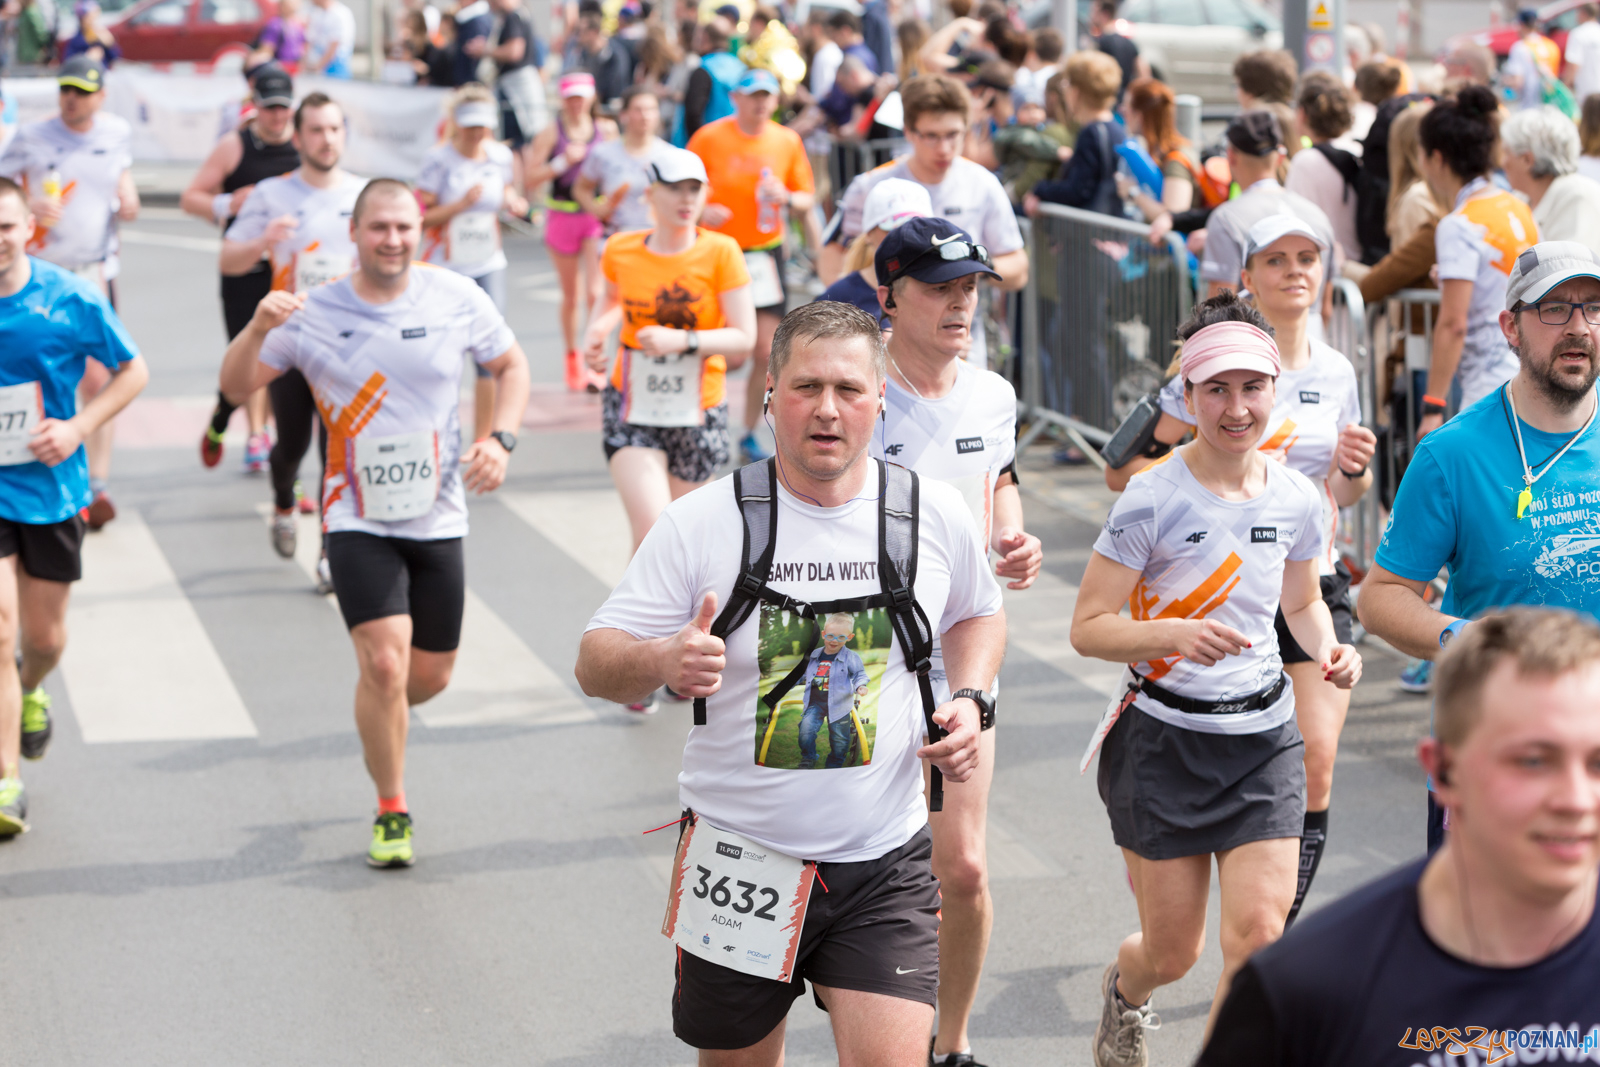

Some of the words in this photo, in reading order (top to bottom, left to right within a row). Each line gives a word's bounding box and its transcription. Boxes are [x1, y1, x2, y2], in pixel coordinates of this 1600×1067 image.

[646, 374, 684, 394] 863
[0, 410, 27, 431] 77
[885, 444, 904, 456] 4F
[363, 459, 432, 486] 12076
[1531, 516, 1540, 529] W
[1543, 508, 1590, 527] POZNANIU
[1186, 531, 1207, 543] 4F
[1566, 543, 1586, 553] MALTA
[766, 562, 804, 582] GAMY
[807, 562, 835, 582] DLA
[1577, 562, 1600, 577] PO
[692, 863, 780, 922] 3632
[711, 913, 742, 930] ADAM
